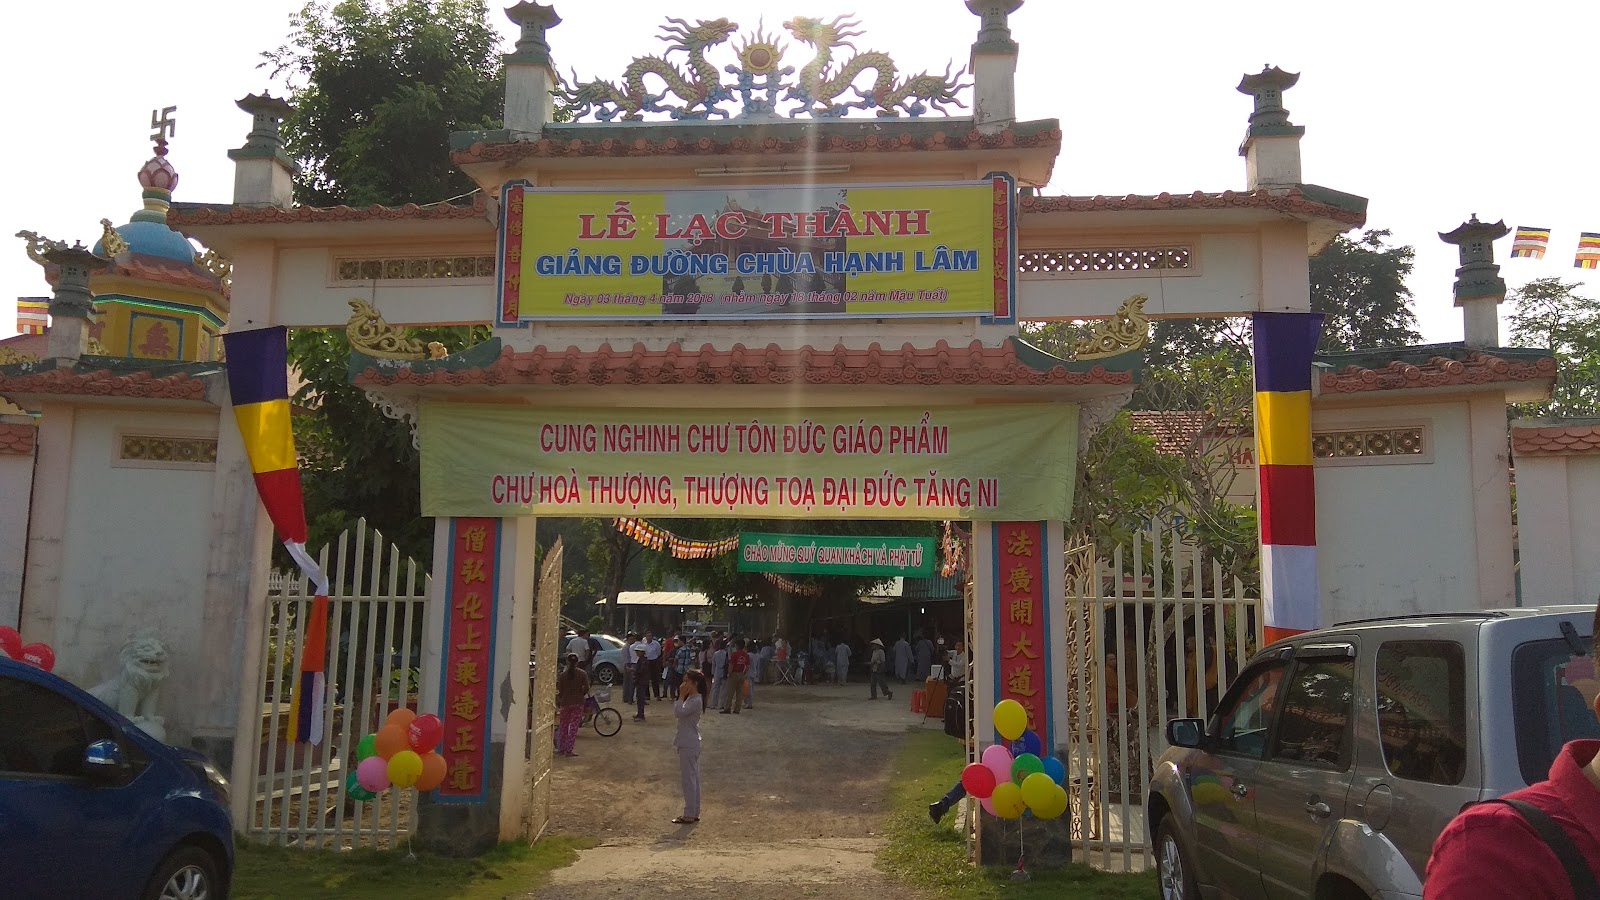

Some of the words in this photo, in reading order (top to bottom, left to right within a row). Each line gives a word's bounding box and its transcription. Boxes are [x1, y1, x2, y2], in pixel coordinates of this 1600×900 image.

[578, 200, 637, 239] LỄ
[654, 211, 748, 246] LẠC
[761, 203, 931, 239] THÀNH
[535, 248, 622, 276] GIẢNG
[629, 249, 729, 277] ĐƯỜNG
[736, 247, 816, 275] CHÙA
[823, 250, 905, 278] HẠNH
[914, 244, 979, 272] LÂM
[564, 292, 593, 306] Ngày
[597, 293, 611, 304] 03
[614, 292, 646, 306] tháng
[649, 293, 657, 304] 4
[659, 293, 684, 304] năm
[686, 292, 715, 304] 2018
[759, 291, 788, 306] ngày
[790, 291, 804, 303] 18
[807, 290, 841, 304] tháng
[844, 291, 858, 302] 02
[889, 289, 914, 303] Mậu
[918, 287, 949, 302] Tuất)
[540, 423, 597, 453] CUNG
[603, 423, 681, 453] NGHINH
[687, 421, 731, 454] CHƯ
[735, 419, 776, 454] TÔN
[783, 419, 826, 454] ĐỨC
[832, 418, 883, 454] GIÁO
[889, 411, 949, 454] PHẨM
[492, 471, 535, 504] CHƯ
[539, 467, 581, 504] HOÀ
[587, 472, 678, 509] THƯỢNG,
[683, 472, 770, 511] THƯỢNG
[775, 476, 817, 512] TOẠ
[822, 476, 857, 512] ĐẠI
[863, 470, 907, 507] ĐỨC
[913, 470, 971, 508] TĂNG
[977, 477, 999, 508] NI
[743, 539, 769, 562] CHÀO
[769, 540, 796, 563] MỪNG
[797, 541, 816, 563] QUÝ
[817, 546, 843, 565] QUAN
[843, 542, 873, 565] KHÁCH
[888, 545, 910, 569] PHẬT
